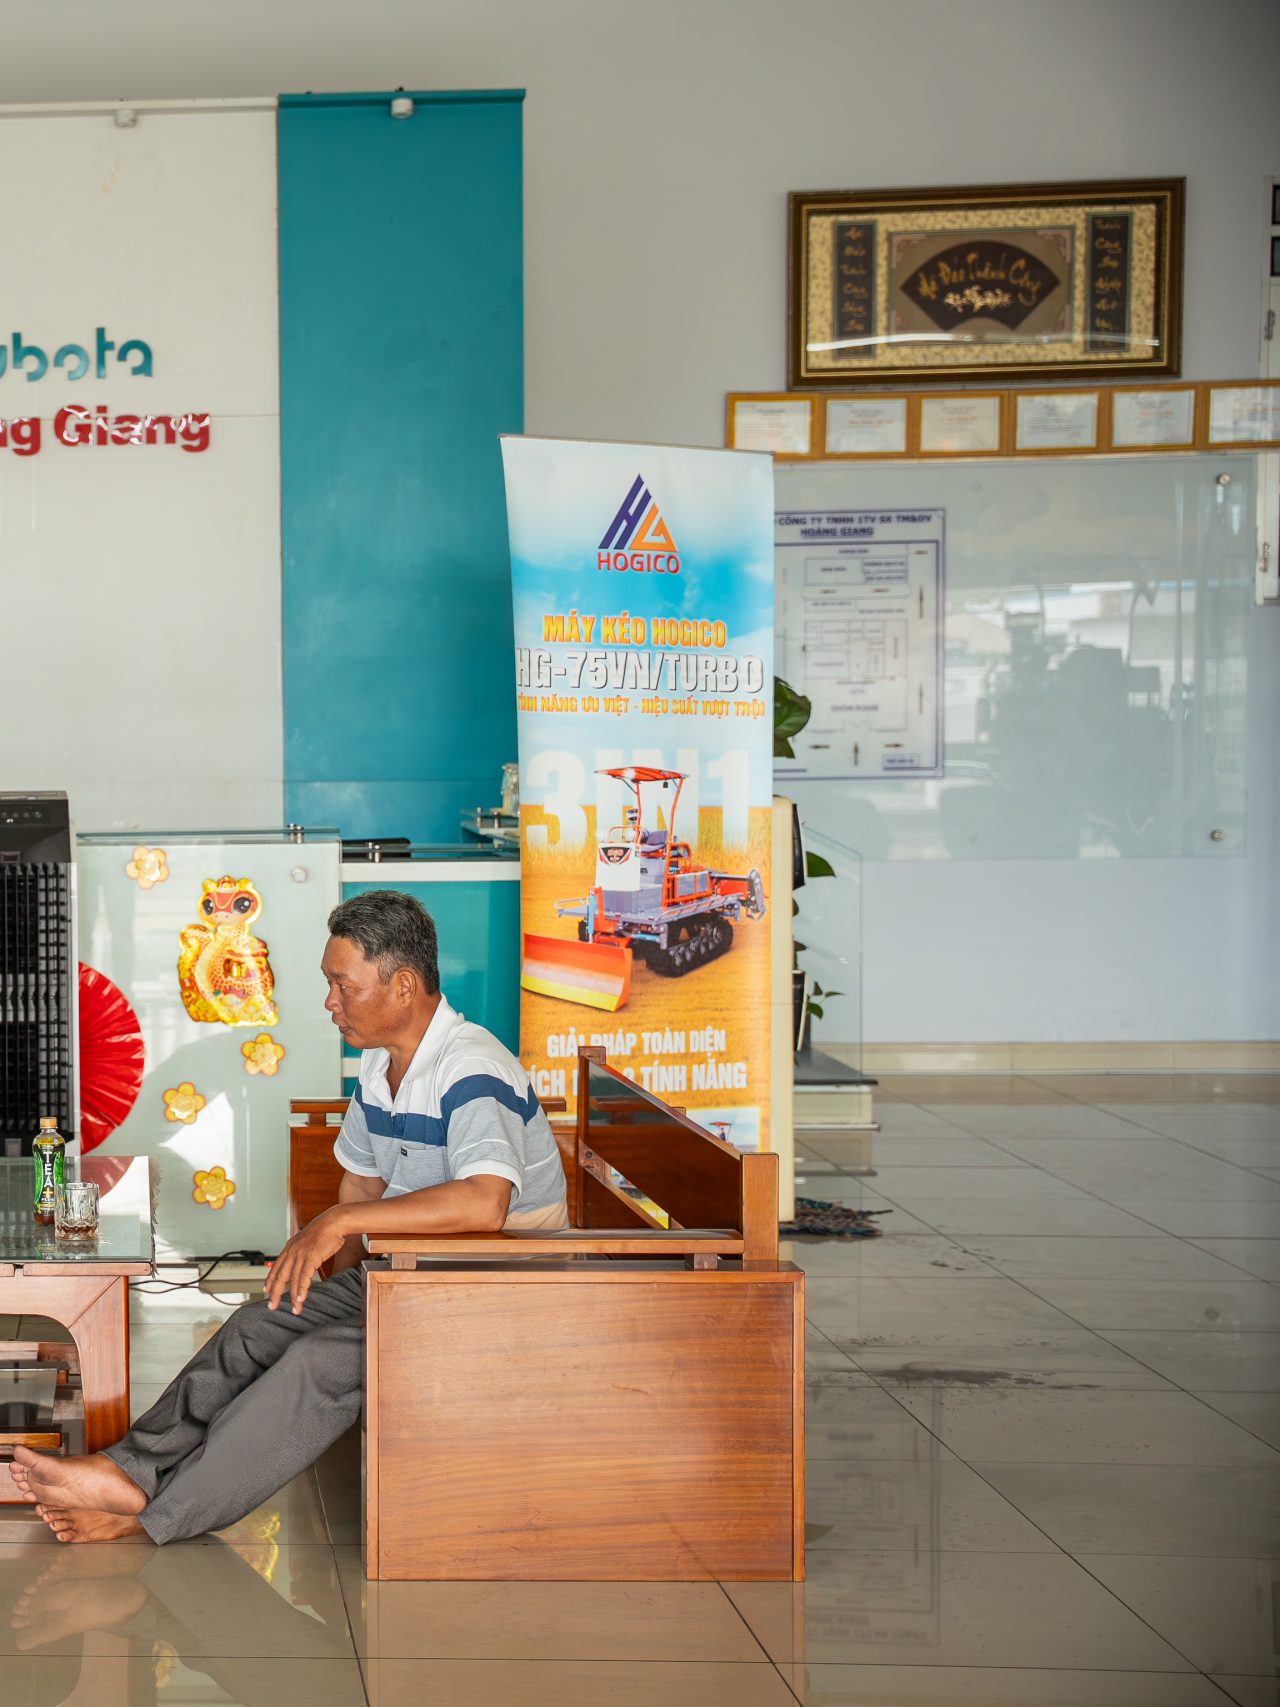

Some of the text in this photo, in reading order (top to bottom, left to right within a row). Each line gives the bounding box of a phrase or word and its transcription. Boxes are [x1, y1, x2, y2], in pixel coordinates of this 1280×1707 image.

[53, 404, 211, 453] Giang
[778, 514, 807, 526] CÔNG
[810, 516, 822, 525] TY
[839, 526, 875, 537] GIANG
[597, 551, 681, 574] HOGICO
[543, 609, 727, 648] MÁY KÉO HOGICO
[517, 647, 765, 693] HG-75VN/TURBO
[541, 693, 578, 713] NĂNG
[641, 696, 669, 718] HIỆU
[734, 698, 766, 720] TRỘI
[641, 1027, 685, 1054] TOÀN
[689, 1025, 726, 1058] DIỆN
[526, 1064, 566, 1098] ÍCH
[640, 1060, 687, 1092] TÍNH
[691, 1057, 748, 1090] NĂNG
